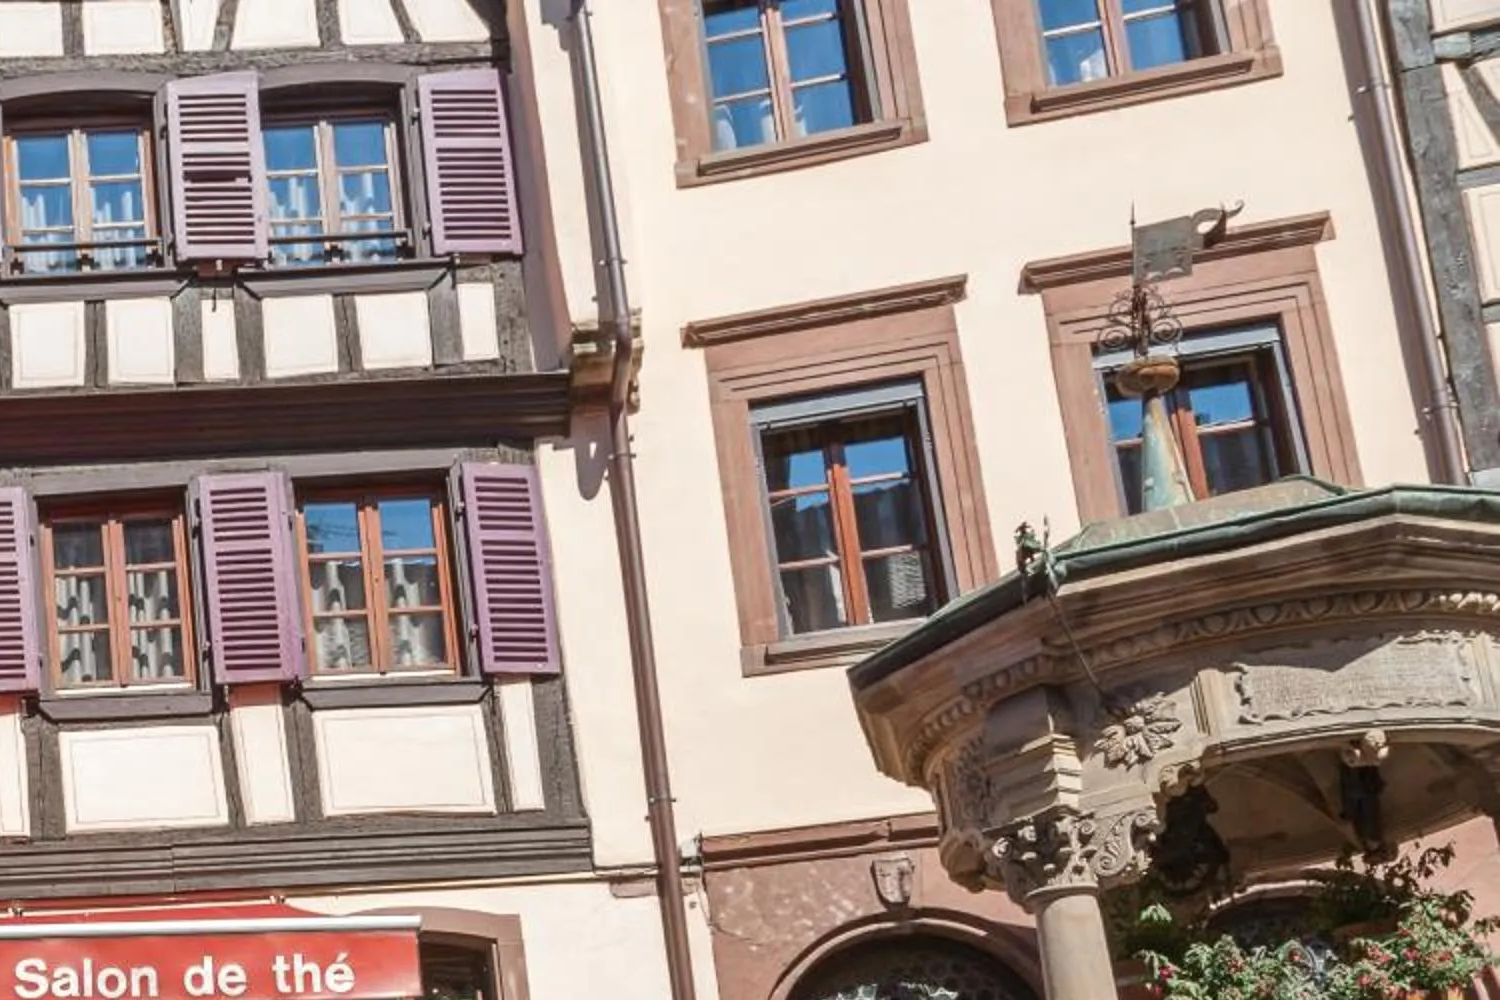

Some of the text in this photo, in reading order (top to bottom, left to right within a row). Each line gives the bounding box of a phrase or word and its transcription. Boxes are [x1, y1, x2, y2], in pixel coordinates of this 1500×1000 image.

[14, 957, 159, 999] Salon
[183, 955, 248, 996] de
[272, 952, 356, 994] thé
